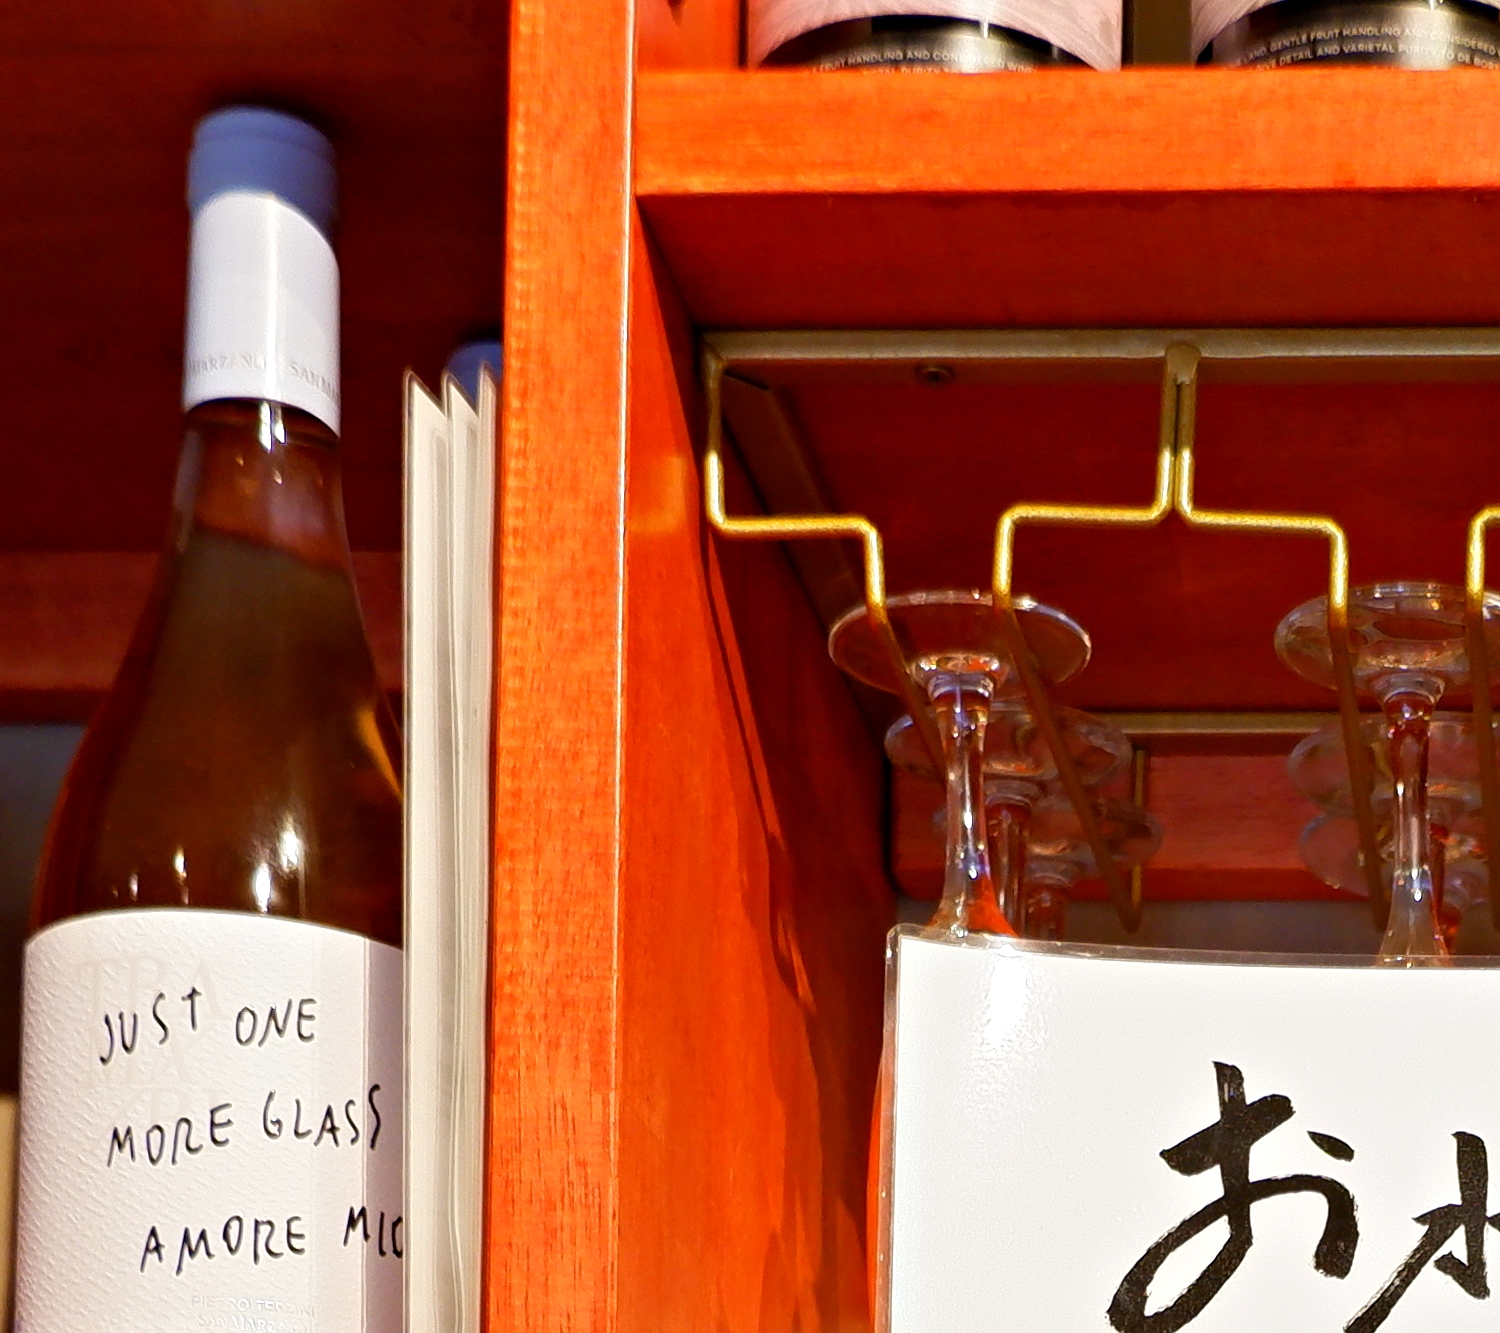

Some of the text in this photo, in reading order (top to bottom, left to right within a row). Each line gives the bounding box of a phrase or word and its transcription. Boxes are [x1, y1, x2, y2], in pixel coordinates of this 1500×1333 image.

[1310, 29, 1340, 42] FRUIT
[1343, 27, 1399, 37] HANDLING
[1317, 45, 1340, 57] AND
[1342, 42, 1394, 53] VARIETAL
[849, 51, 903, 66] HANDLING
[907, 50, 929, 60] AND
[100, 987, 202, 1065] JUST
[235, 998, 316, 1048] ONE
[107, 1083, 382, 1167] MORE GLASS
[141, 1215, 305, 1276] AMORE
